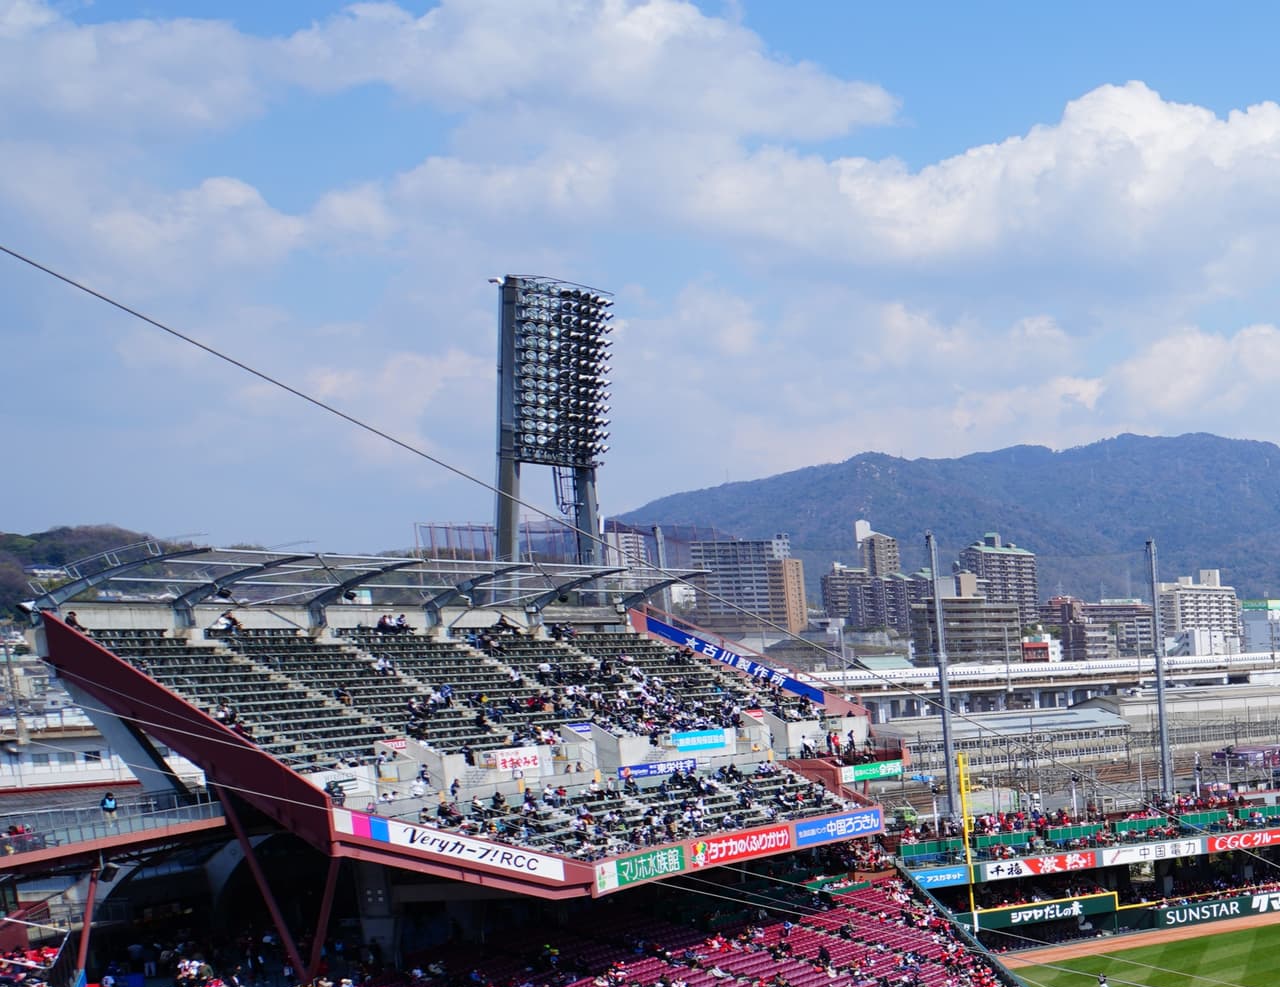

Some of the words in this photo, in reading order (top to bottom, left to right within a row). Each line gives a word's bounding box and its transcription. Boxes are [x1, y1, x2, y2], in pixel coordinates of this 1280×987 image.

[827, 813, 880, 837] 中国ろうきん
[500, 852, 539, 871] RCC
[1138, 841, 1196, 859] 中国電力
[620, 849, 681, 882] マリホ水族館
[1165, 901, 1240, 926] SUNSTAR
